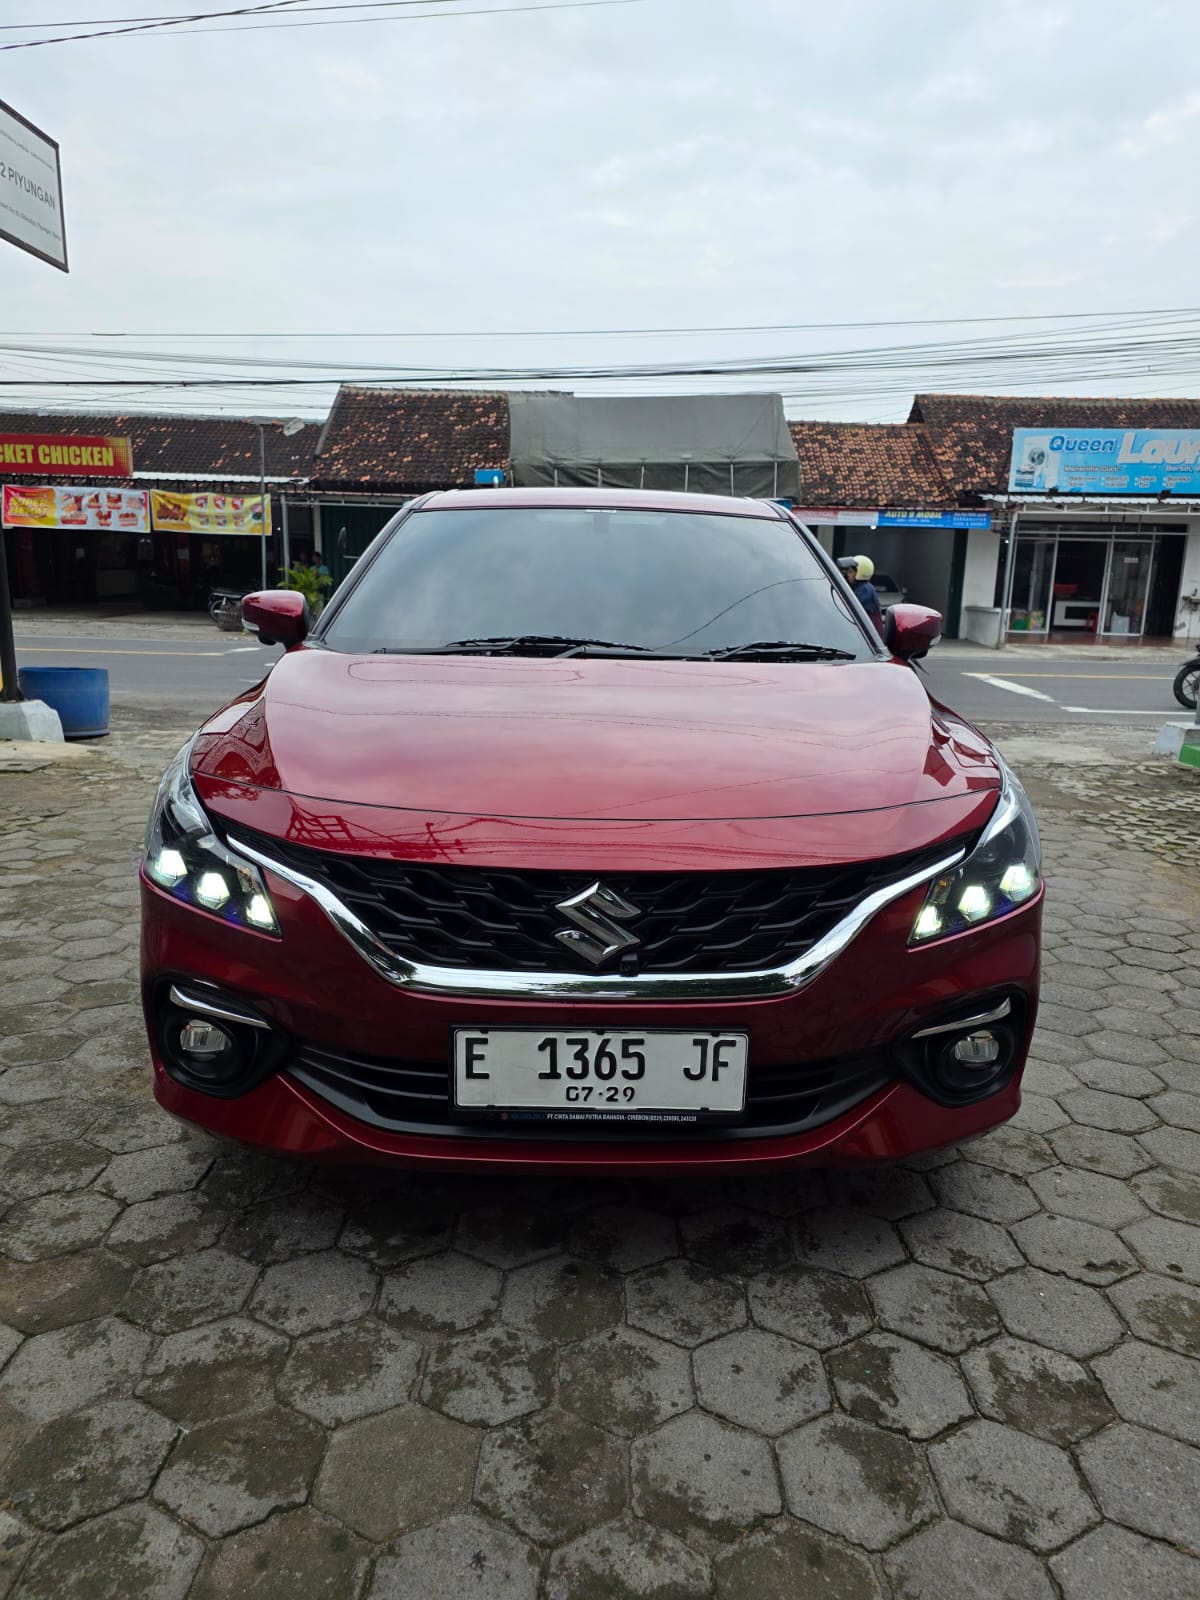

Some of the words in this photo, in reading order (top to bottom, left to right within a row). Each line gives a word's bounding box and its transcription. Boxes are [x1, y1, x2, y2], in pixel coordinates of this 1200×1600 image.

[8, 167, 55, 210] PIYUNGAN
[38, 445, 114, 467] CHICKEN
[1049, 434, 1115, 453] Queen
[465, 1037, 490, 1080] E
[537, 1037, 646, 1081] 1365
[683, 1038, 737, 1082] JF
